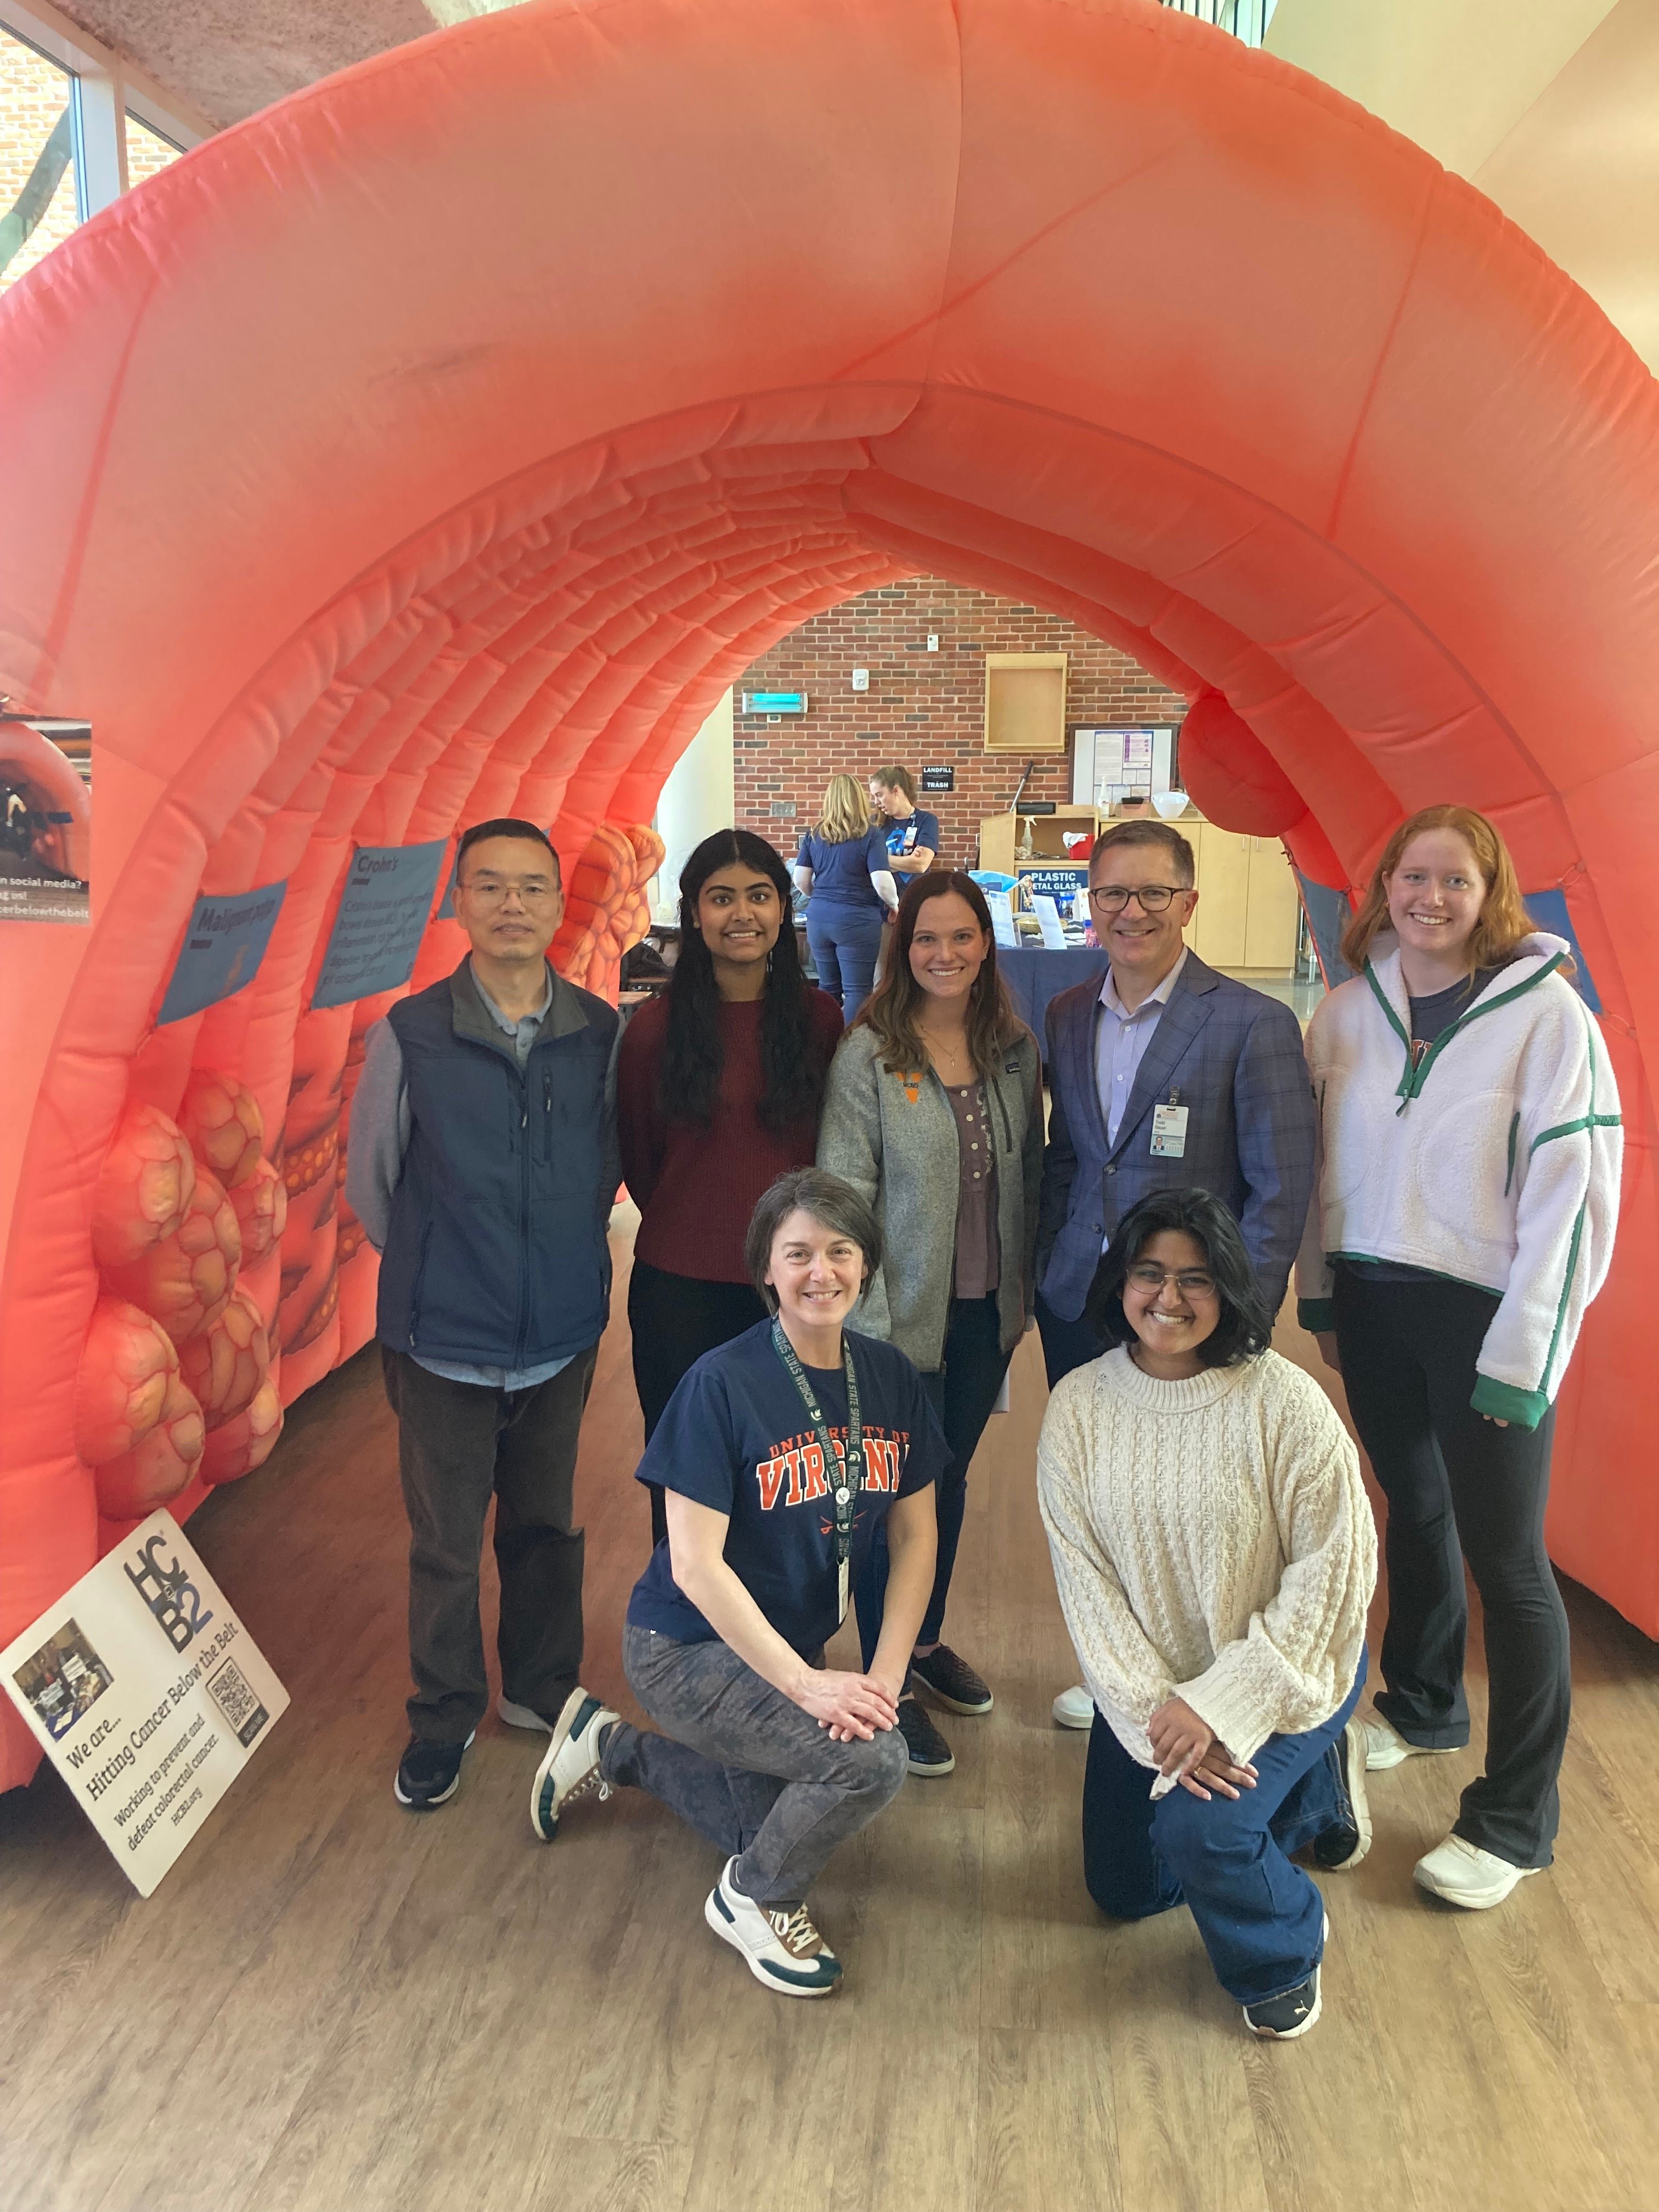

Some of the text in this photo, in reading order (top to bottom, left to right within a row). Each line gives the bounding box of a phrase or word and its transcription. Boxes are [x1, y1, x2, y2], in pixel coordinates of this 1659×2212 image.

[10, 877, 41, 887] social
[43, 879, 82, 889] media?
[358, 855, 399, 873] Crohn's
[1031, 872, 1076, 881] PLASTIC
[772, 1319, 817, 1407] MICHIGAN STATE SPARTANS
[845, 1351, 860, 1444] MICHIGAN STATE SPARTANS
[769, 1425, 910, 1459] UNIVRSTY OF
[818, 1425, 836, 1463] SPARTANS
[830, 1463, 842, 1486] STATE
[847, 1466, 859, 1499] MICHIGAN
[86, 1622, 239, 1801] Hitting Cancer Below the Belt
[66, 1718, 121, 1769] We are...
[114, 1713, 205, 1826] Working to prevent and
[127, 1813, 157, 1851] defeat
[154, 1762, 194, 1817] colorectal
[171, 1786, 203, 1826] HCB2.org
